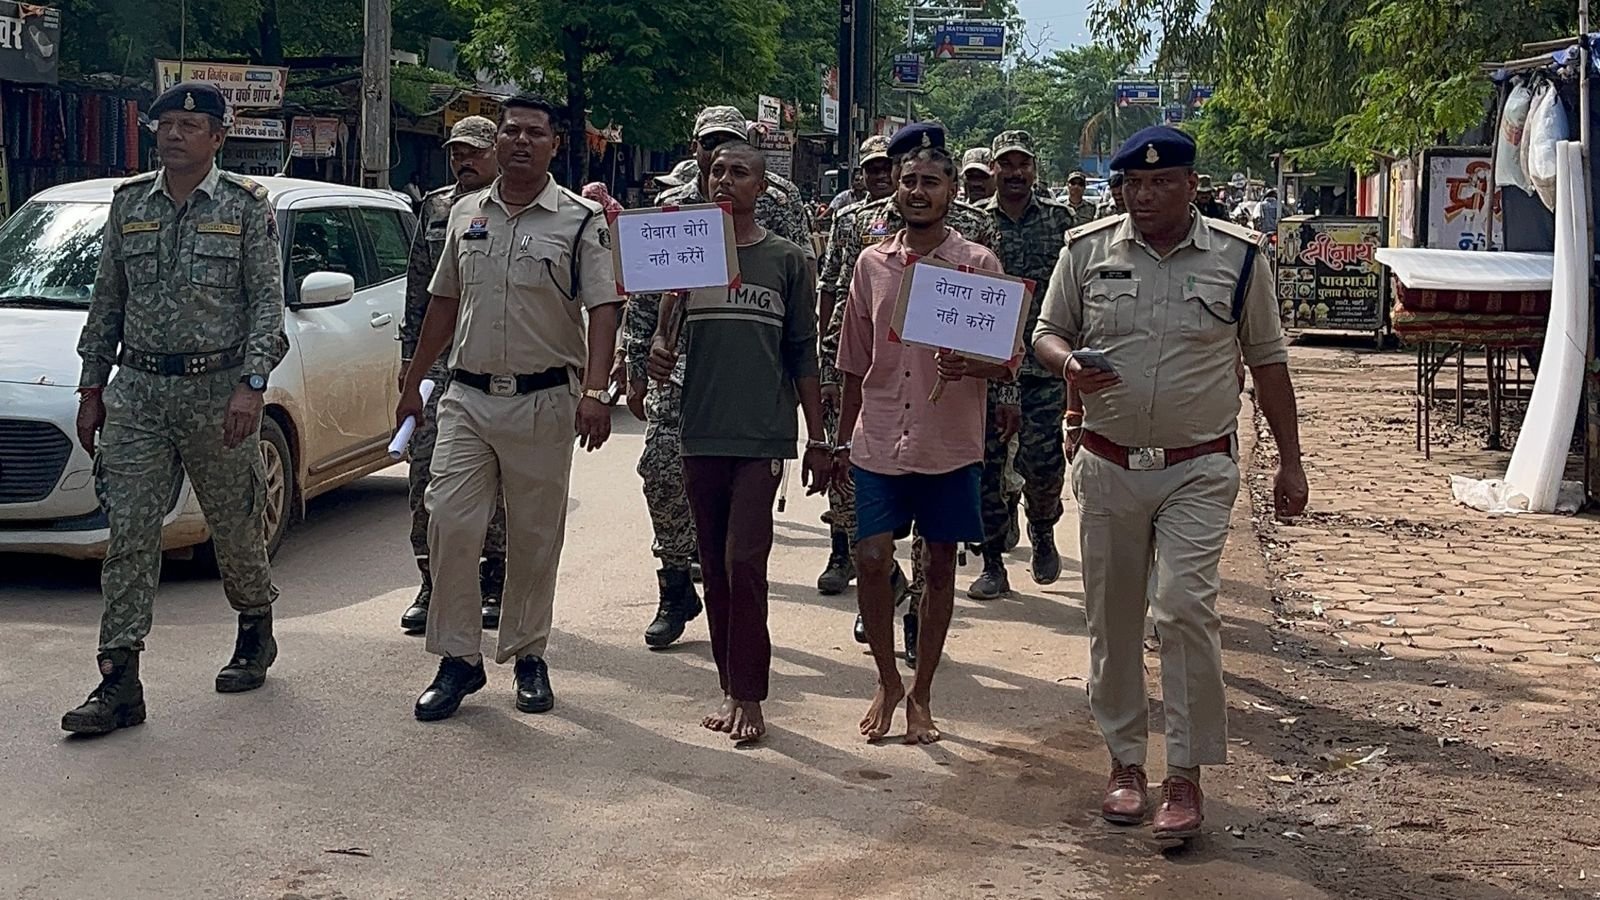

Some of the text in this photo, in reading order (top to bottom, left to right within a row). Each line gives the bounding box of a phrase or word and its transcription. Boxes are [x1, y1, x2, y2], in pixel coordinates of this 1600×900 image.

[191, 69, 206, 80] जय
[235, 83, 252, 102] वर्क
[252, 85, 271, 102] शॉप
[641, 219, 708, 240] दोबारा चोरी
[649, 249, 670, 266] नही
[1300, 233, 1374, 271] श्रीनाथ
[1320, 273, 1377, 288] पावभाजी
[935, 277, 1007, 306] दोबारा चोरी
[936, 307, 959, 325] नही
